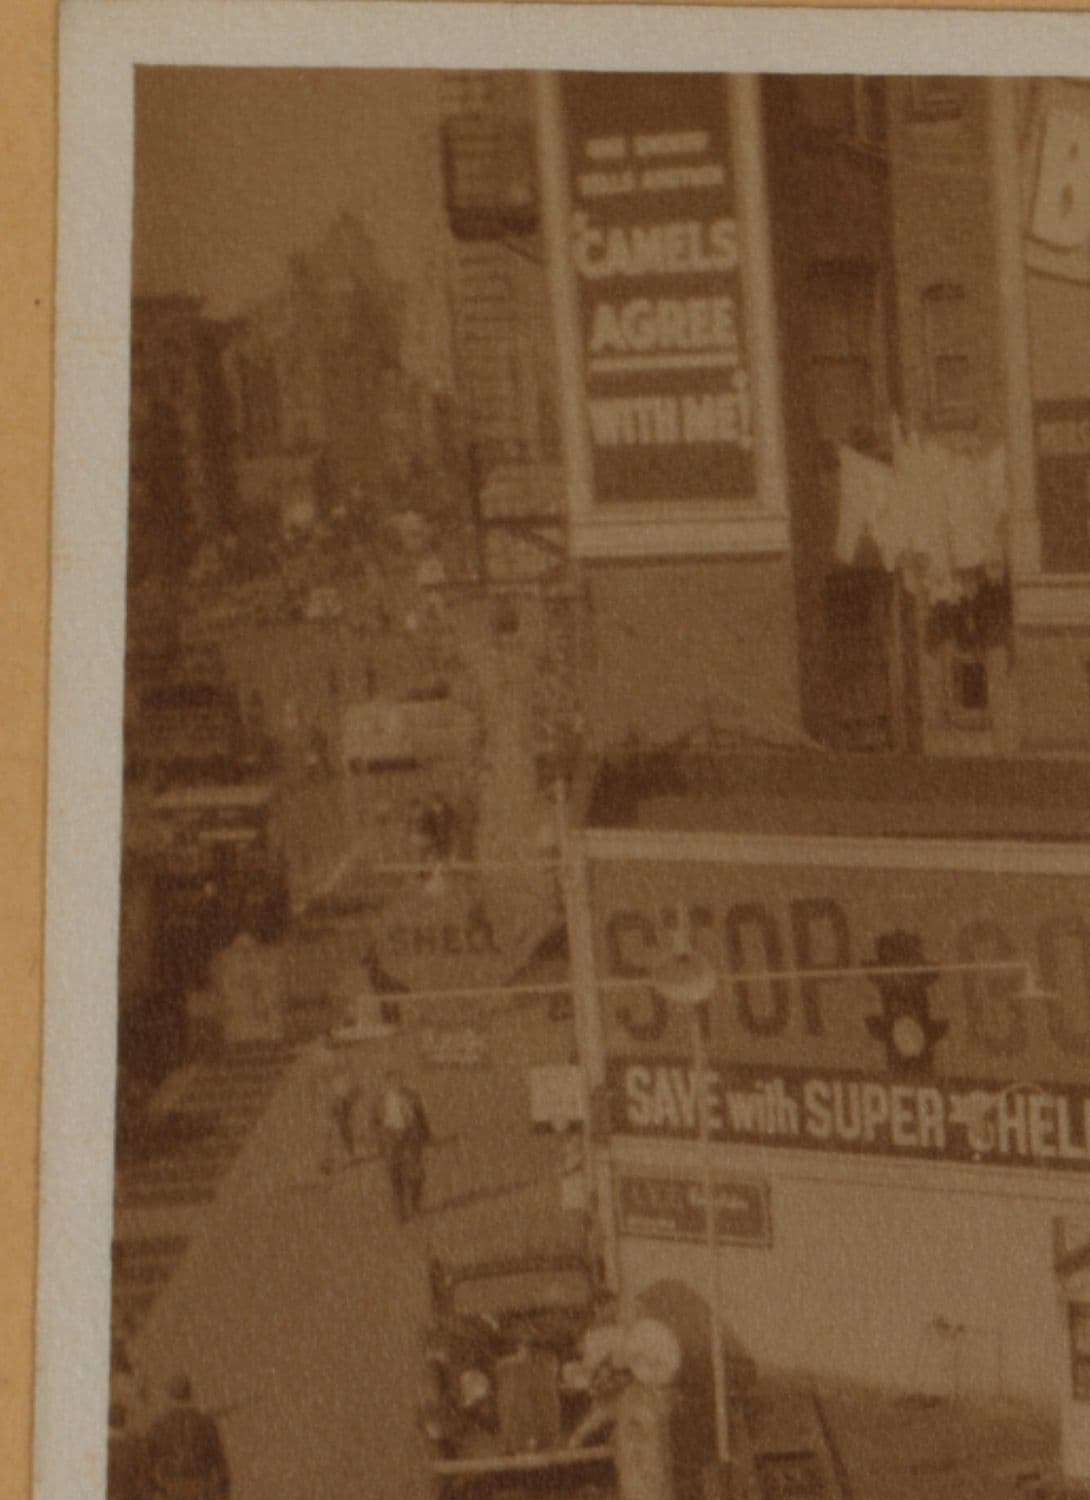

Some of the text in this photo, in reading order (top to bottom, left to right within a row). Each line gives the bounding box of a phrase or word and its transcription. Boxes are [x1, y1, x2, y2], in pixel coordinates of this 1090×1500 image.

[587, 296, 738, 351] AGREE
[587, 395, 679, 446] WITH
[605, 898, 851, 1045] STOP
[624, 1065, 722, 1130] SAVE
[727, 1078, 799, 1135] with
[804, 1079, 946, 1148] SUPER
